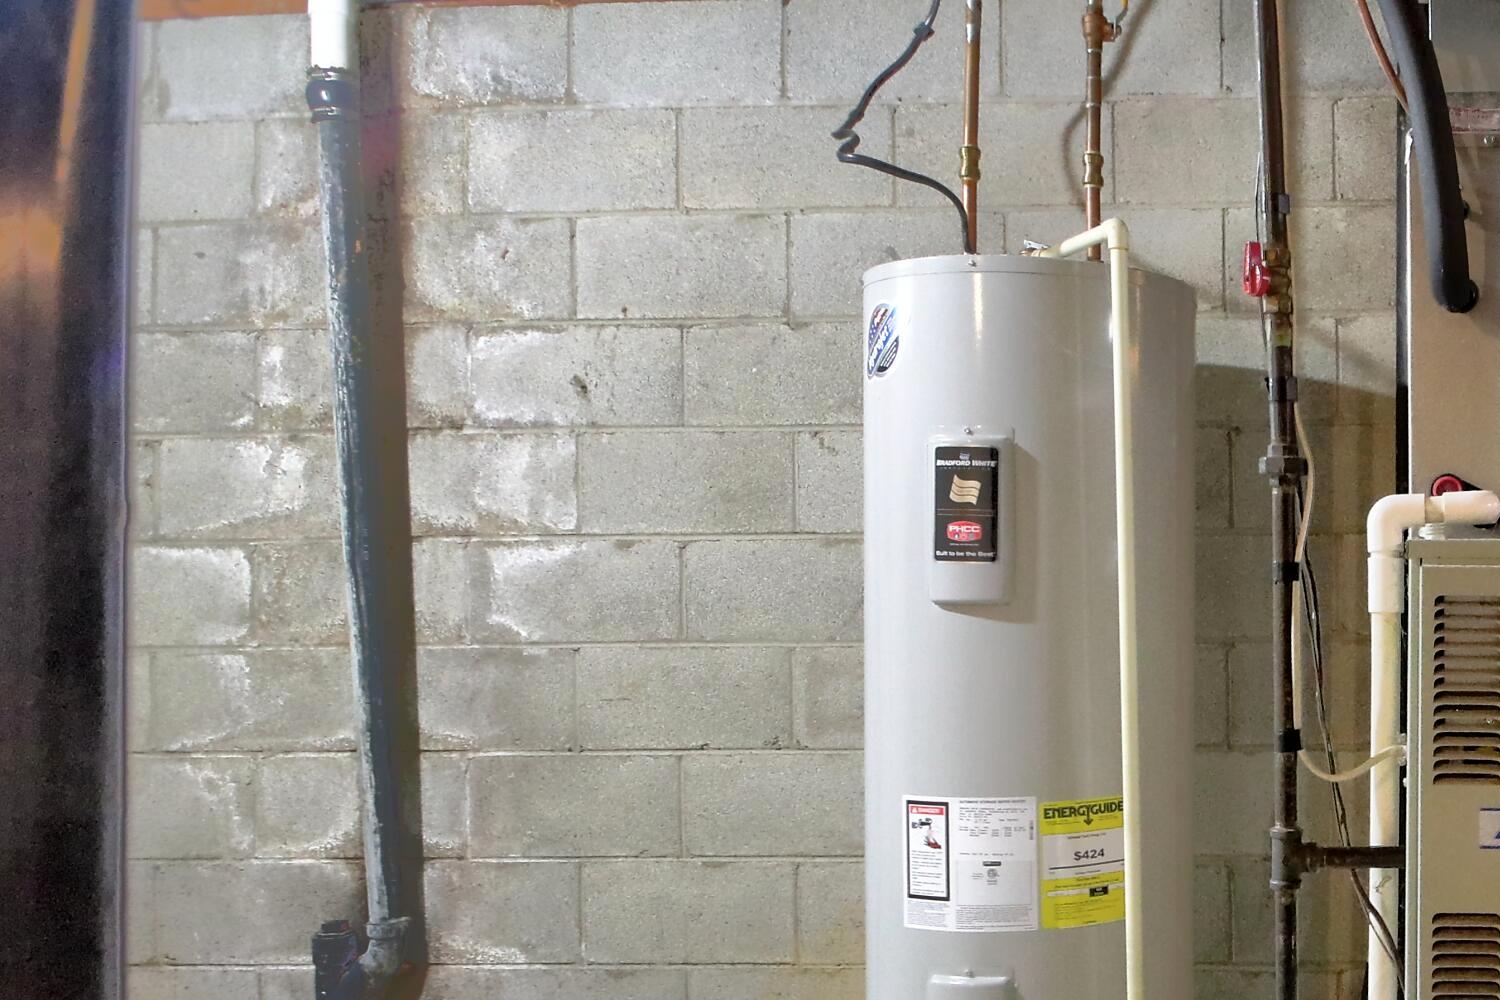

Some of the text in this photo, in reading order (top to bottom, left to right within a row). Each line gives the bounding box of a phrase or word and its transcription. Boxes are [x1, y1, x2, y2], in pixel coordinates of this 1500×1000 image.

[936, 459, 997, 467] BRADFORD WHITE
[948, 525, 981, 533] PHCC
